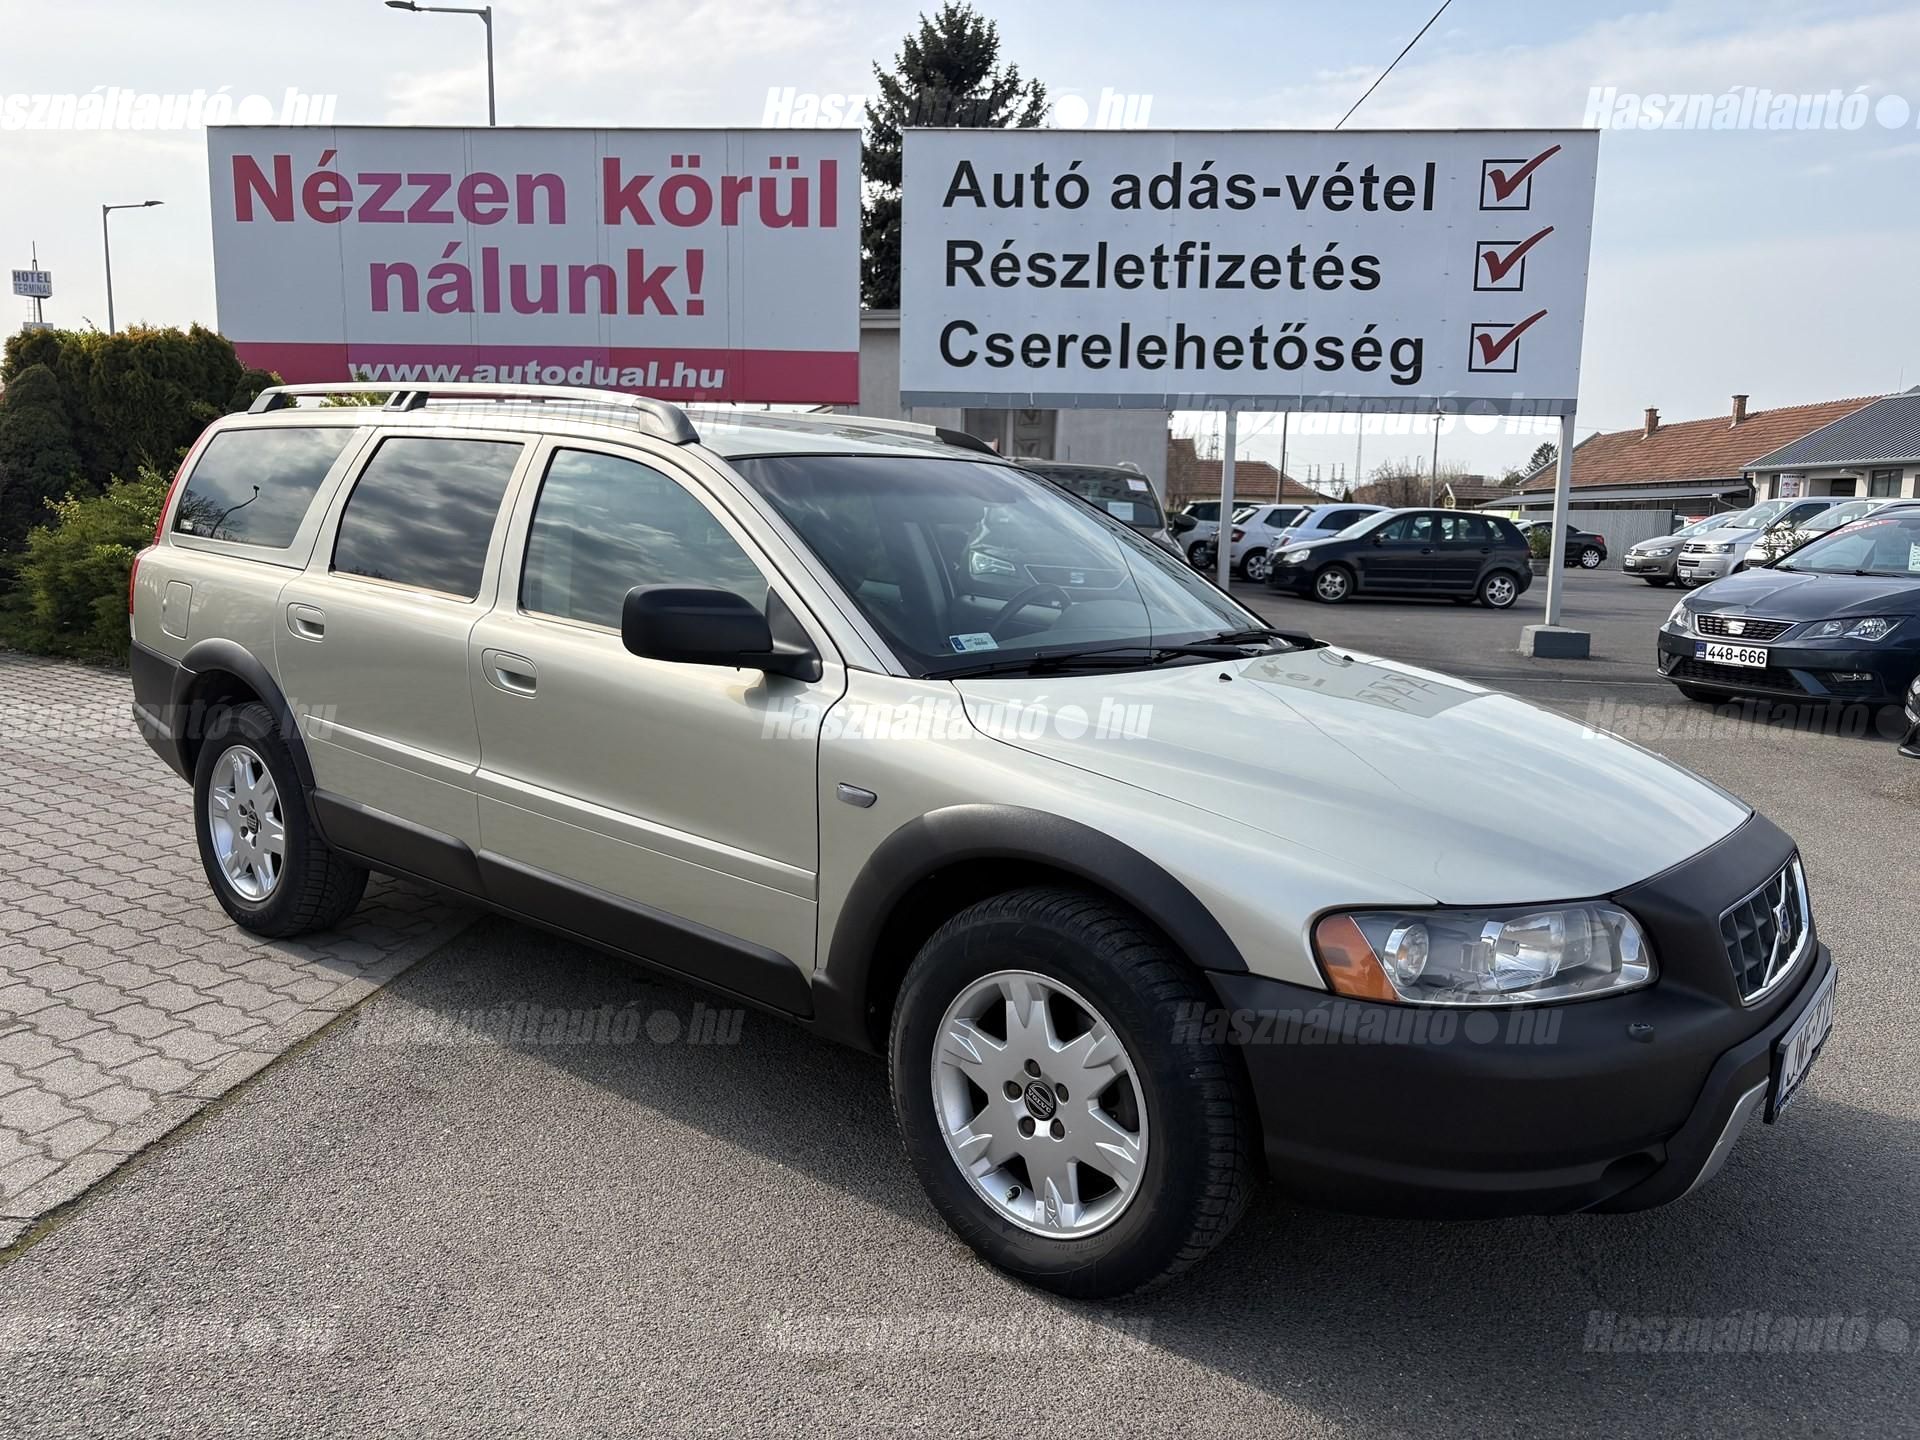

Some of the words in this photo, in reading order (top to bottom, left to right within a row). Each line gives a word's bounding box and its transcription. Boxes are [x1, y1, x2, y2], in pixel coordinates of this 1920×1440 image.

[232, 149, 566, 225] Nézzen
[603, 154, 838, 228] körül
[943, 159, 1089, 209] Autó
[1111, 160, 1436, 211] adás-vétel
[14, 271, 51, 283] HOTEL
[370, 241, 705, 316] nálunk!
[946, 239, 1381, 291] Részletfizetés
[348, 358, 725, 389] www.autodual.hu
[939, 319, 1424, 386] Cserelehetőség
[1708, 645, 1766, 664] 448-666
[1027, 1088, 1052, 1114] VOLVO
